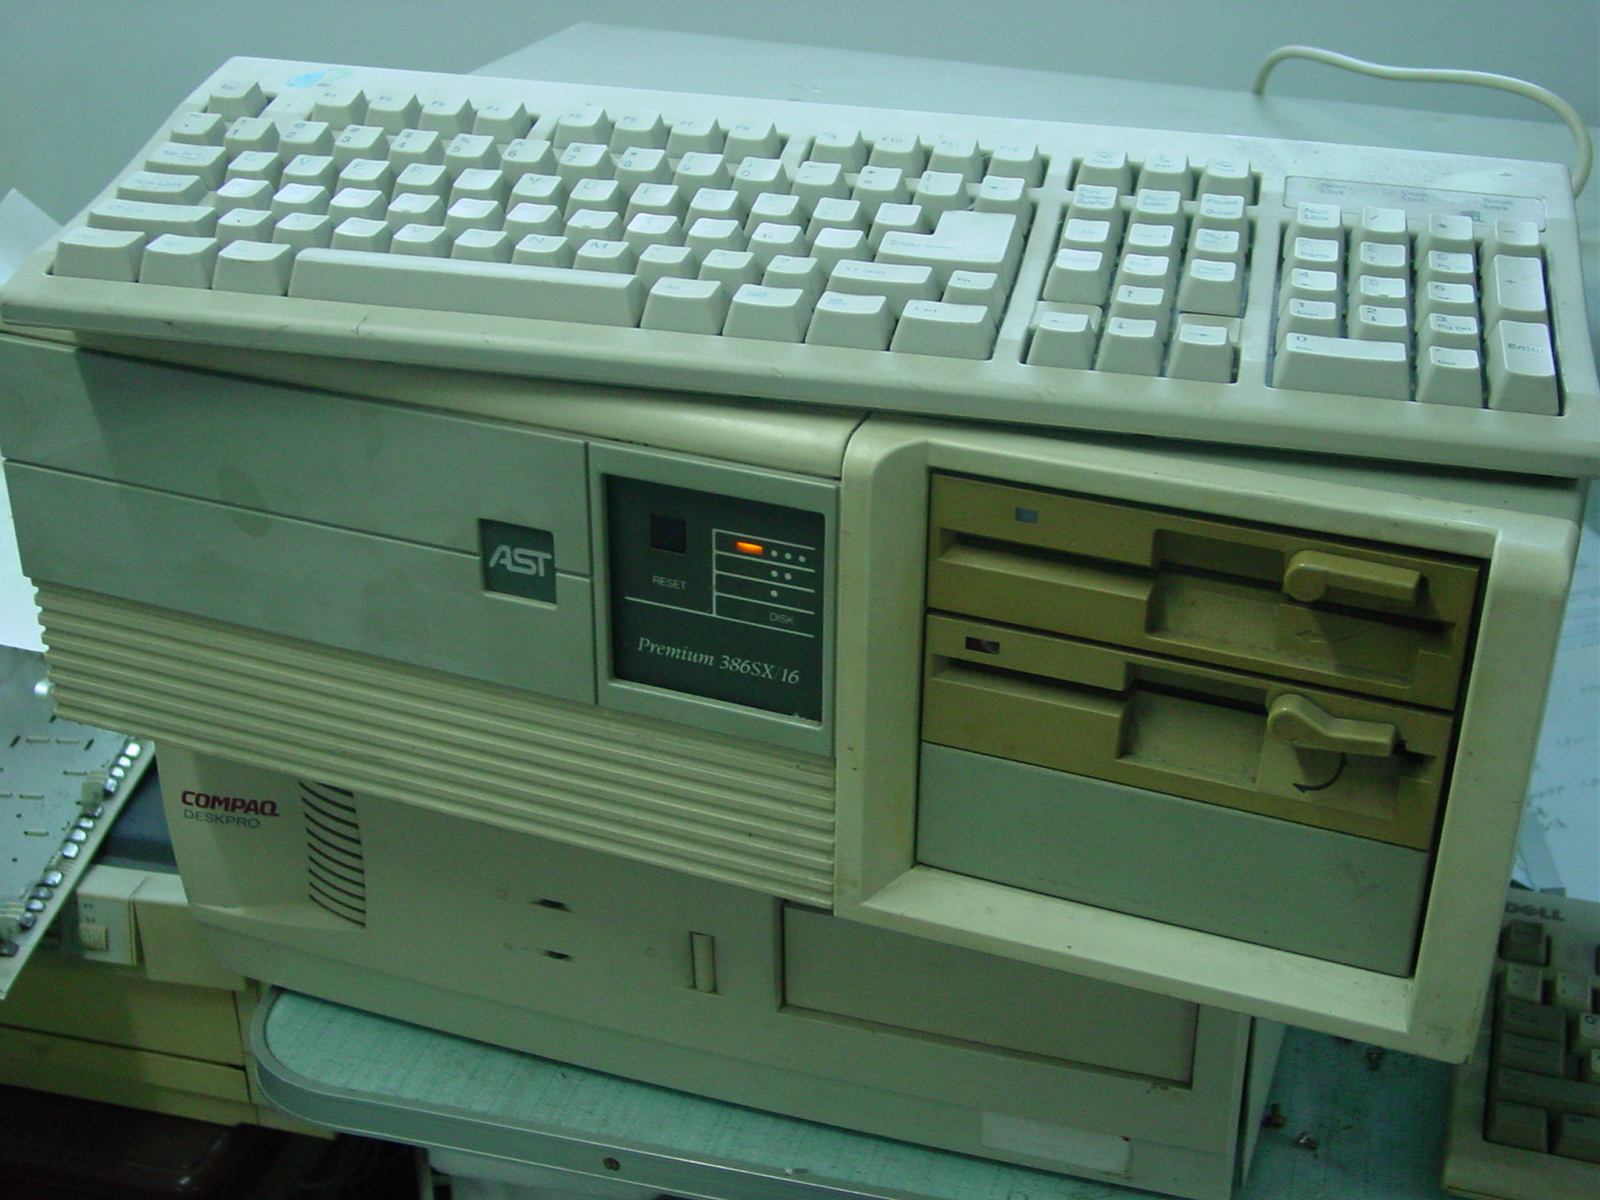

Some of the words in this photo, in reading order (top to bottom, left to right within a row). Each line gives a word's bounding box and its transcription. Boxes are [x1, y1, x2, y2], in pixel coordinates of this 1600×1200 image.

[489, 544, 552, 577] AST
[652, 575, 687, 590] RESET
[769, 612, 794, 624] DISK
[637, 636, 715, 667] Premium
[181, 790, 280, 817] COMPAQ
[183, 809, 261, 828] DESKPRO
[1505, 901, 1564, 921] DELL
